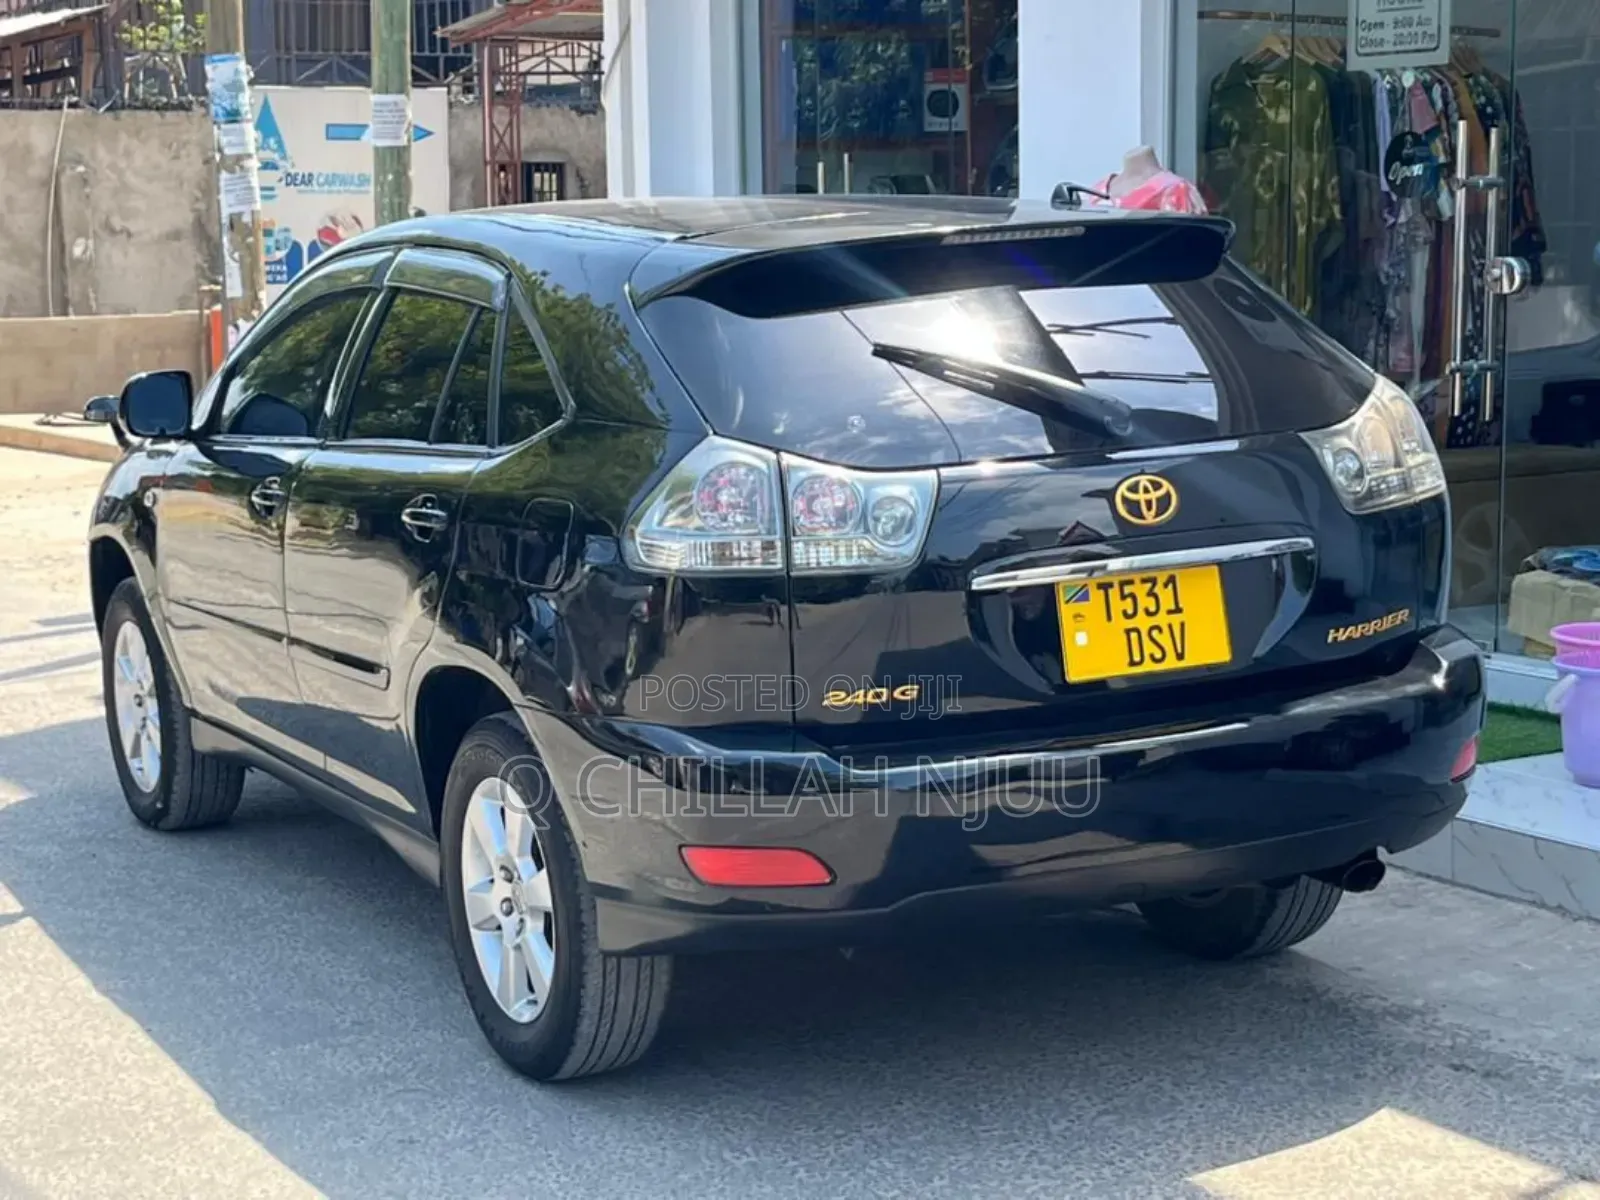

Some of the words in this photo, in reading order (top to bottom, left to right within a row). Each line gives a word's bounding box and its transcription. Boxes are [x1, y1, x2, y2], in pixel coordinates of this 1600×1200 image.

[285, 173, 314, 187] DEAR
[1388, 161, 1424, 186] Open
[1097, 574, 1183, 622] T531
[1327, 608, 1410, 644] HARRIER
[1124, 622, 1185, 667] DSV
